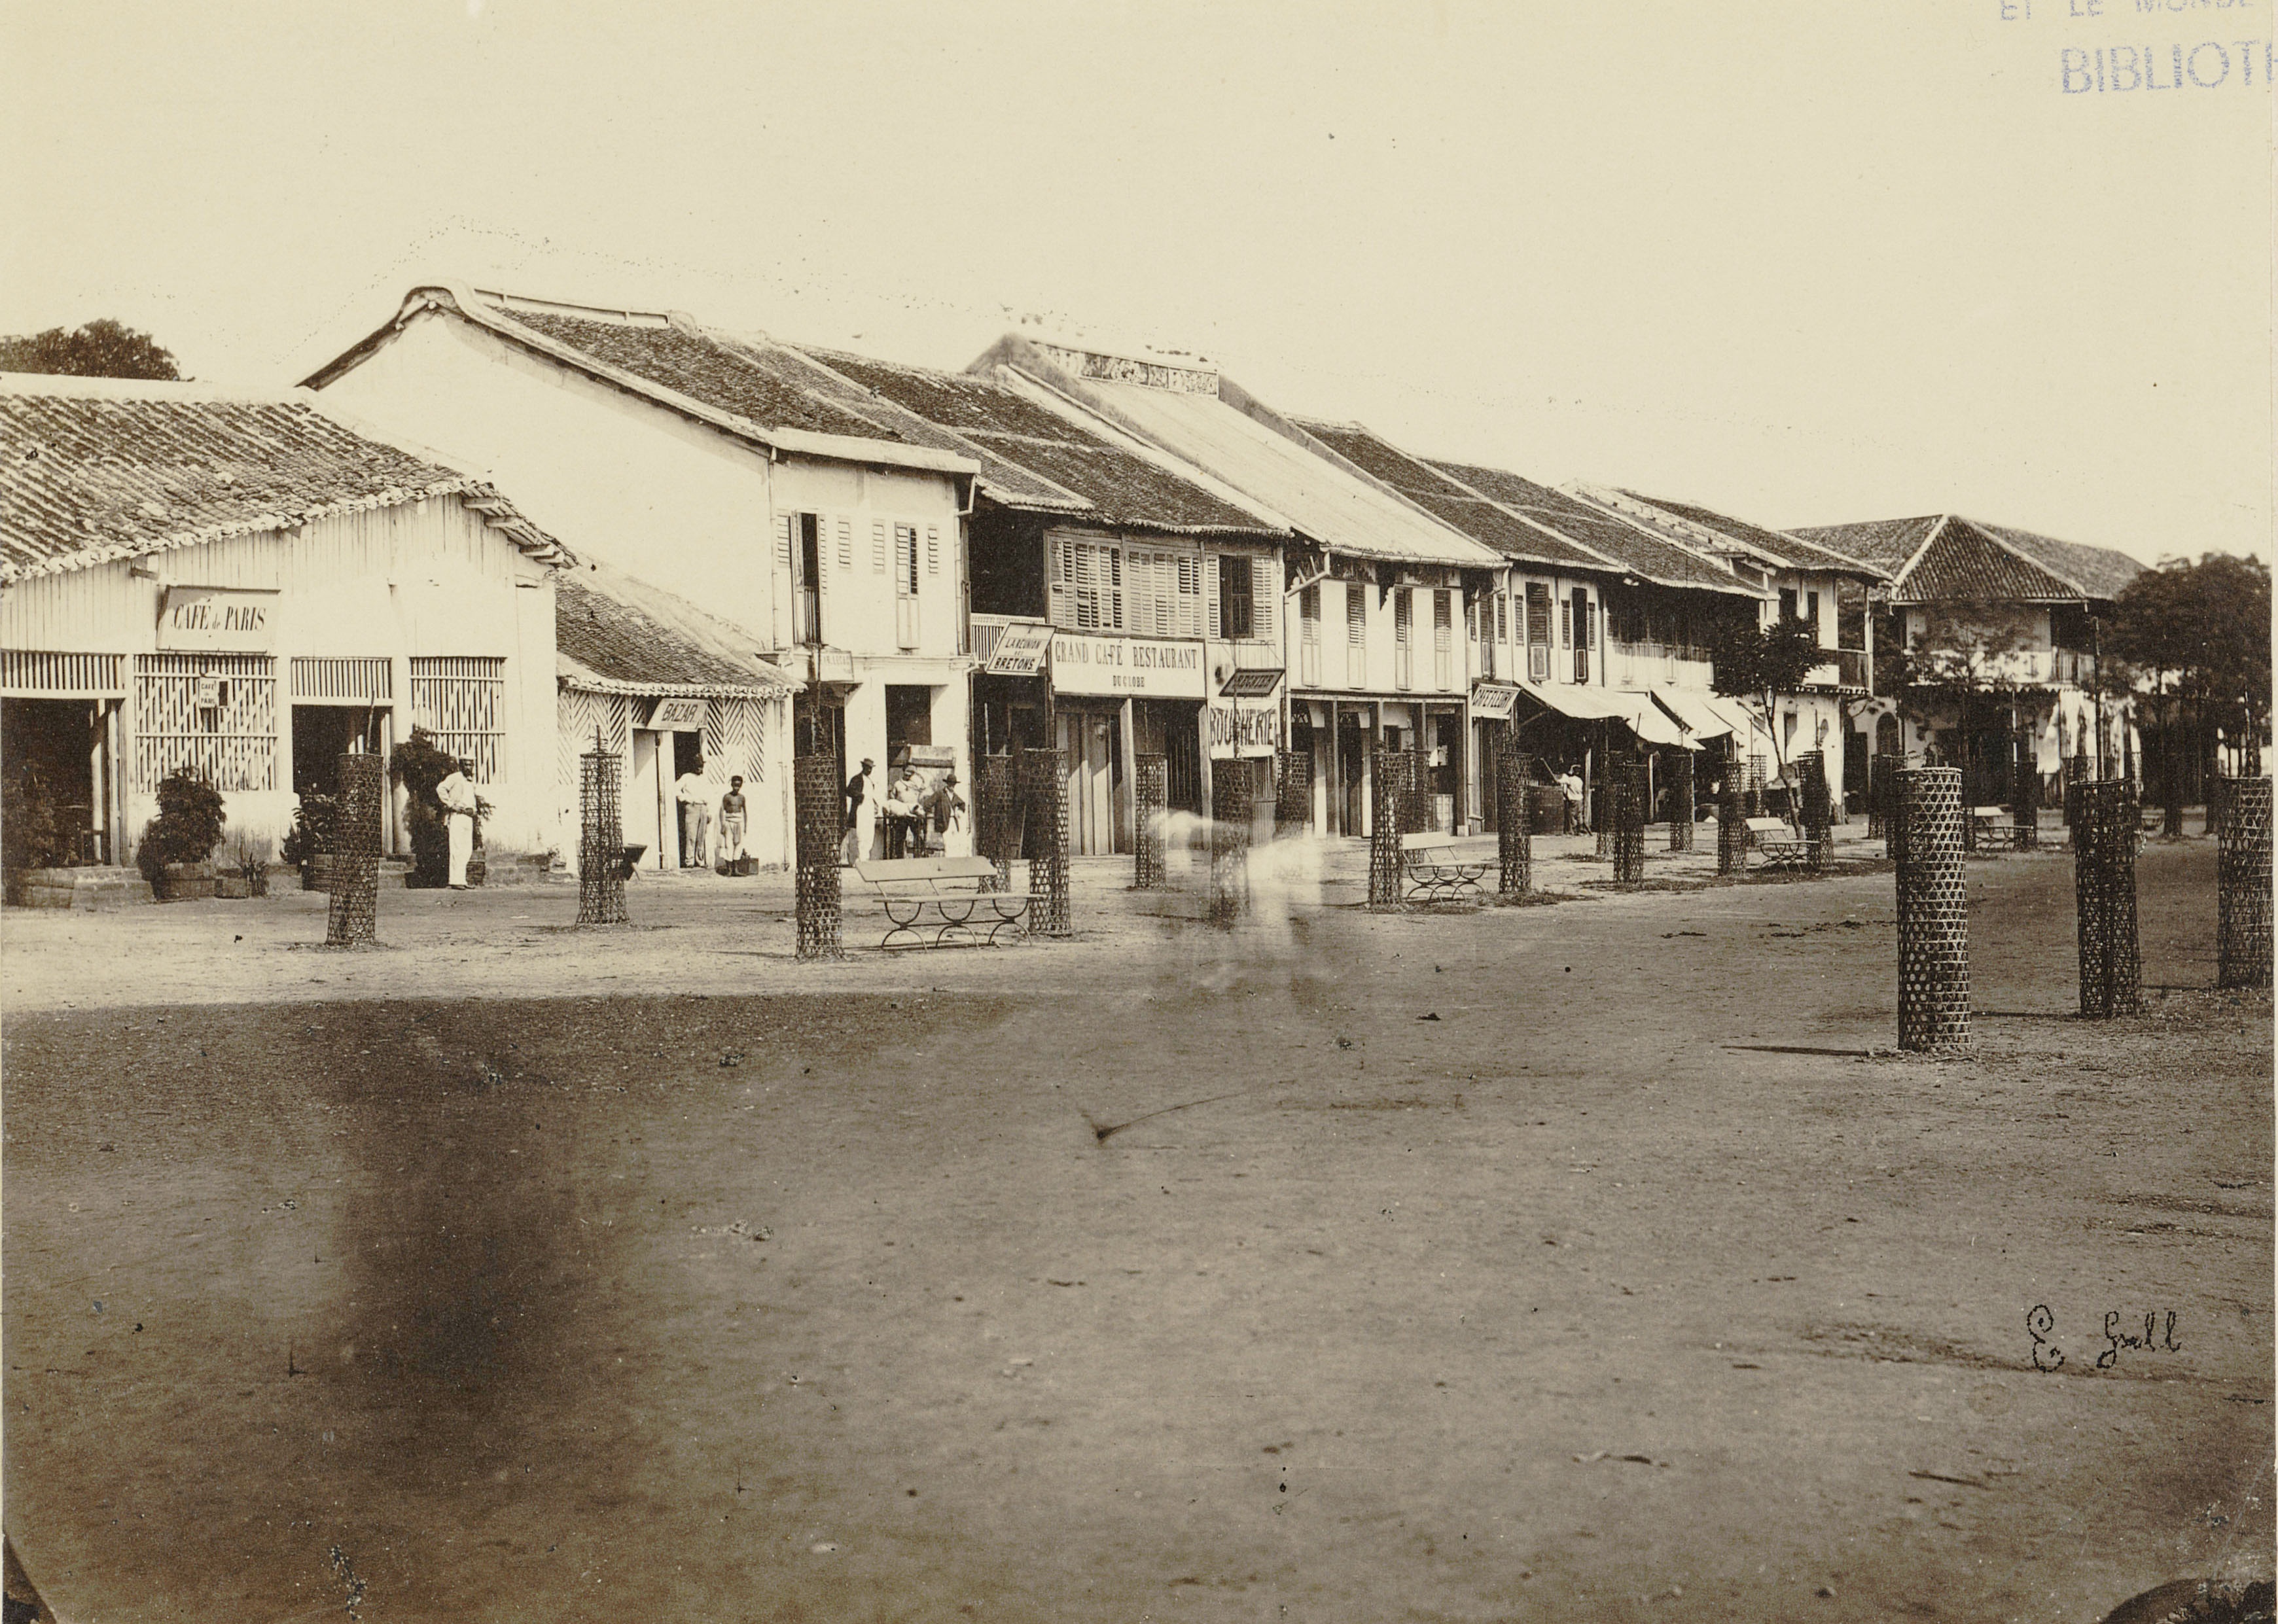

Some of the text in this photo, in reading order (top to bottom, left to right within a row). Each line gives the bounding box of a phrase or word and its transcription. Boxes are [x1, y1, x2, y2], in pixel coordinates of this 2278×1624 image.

[173, 598, 211, 630] CAFÉ
[224, 606, 266, 632] PARIS
[994, 657, 1035, 670] BRETONS
[1055, 639, 1197, 669] GRAND CAFÉ RESTAURANT
[662, 703, 698, 722] BAZAR
